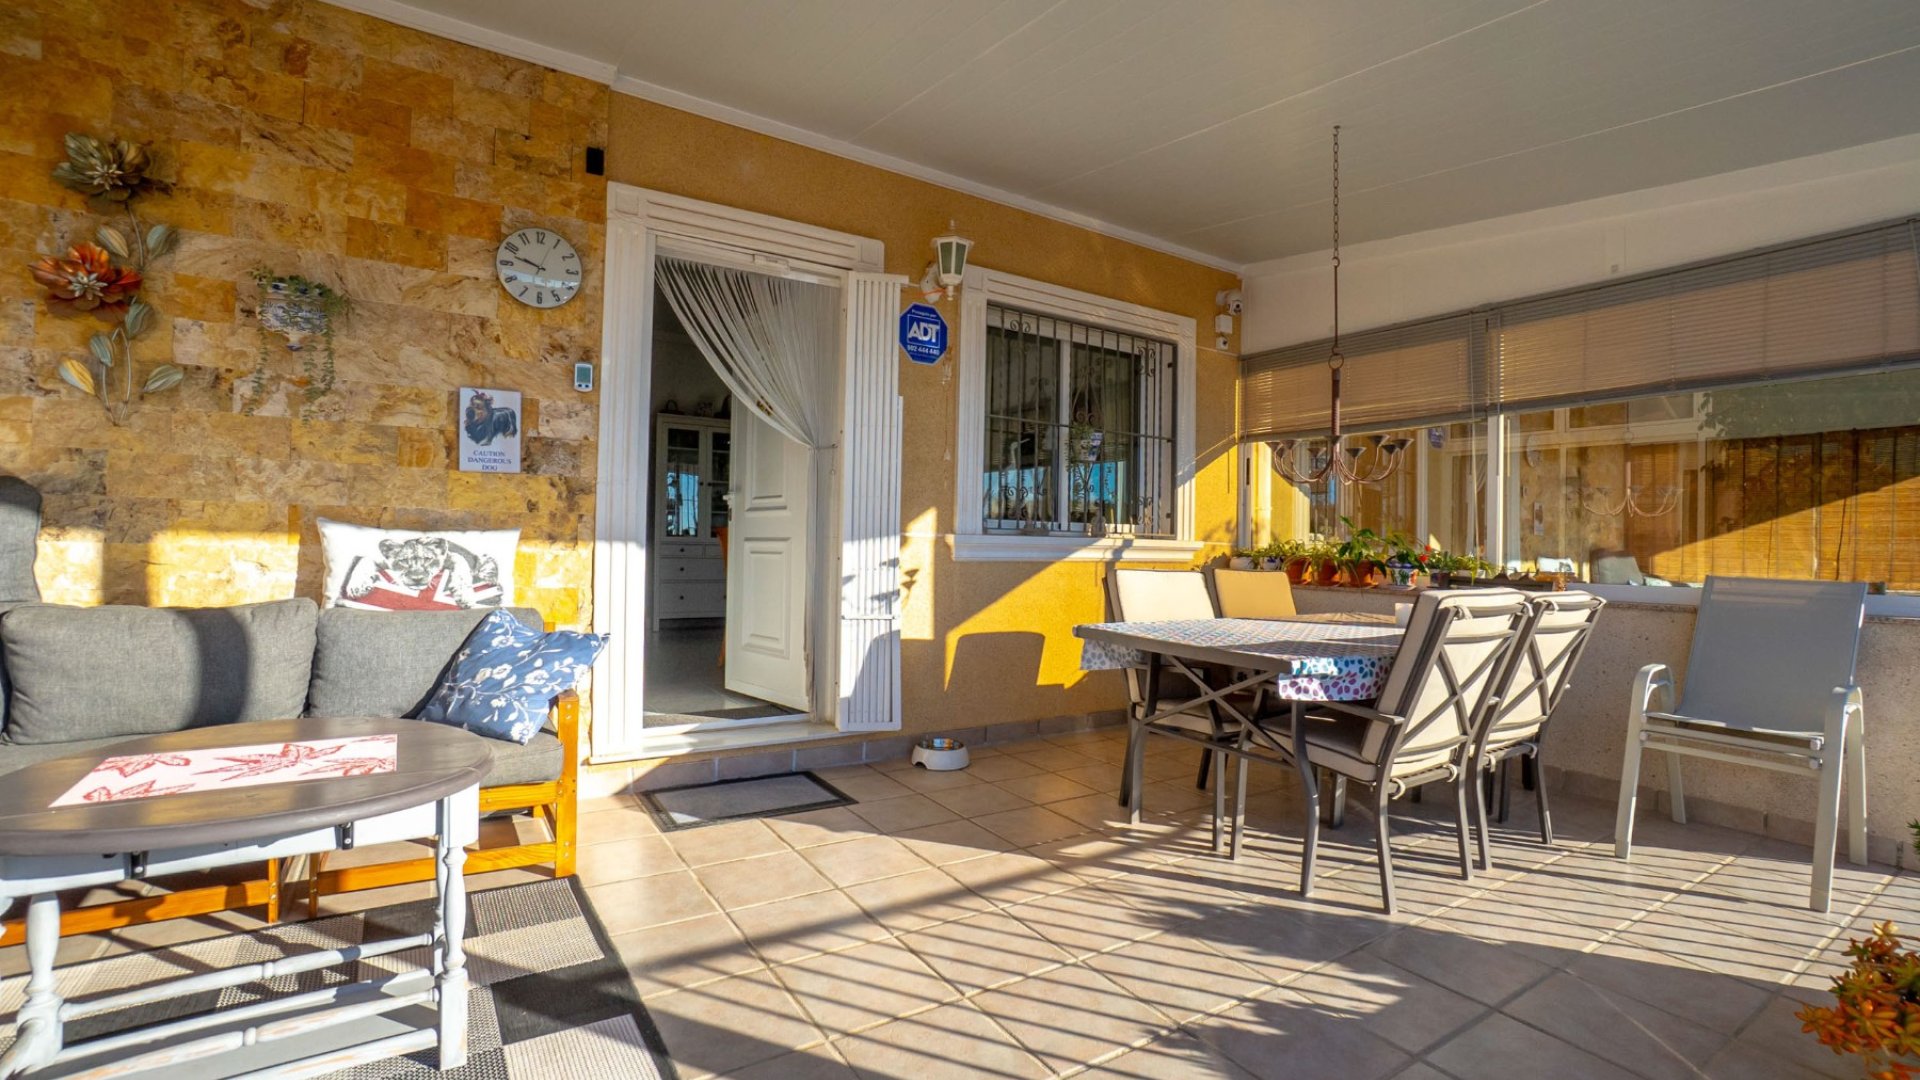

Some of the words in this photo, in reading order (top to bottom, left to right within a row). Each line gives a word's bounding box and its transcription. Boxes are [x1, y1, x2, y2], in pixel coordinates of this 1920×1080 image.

[518, 232, 530, 245] 11
[536, 232, 546, 245] 12
[553, 239, 561, 249] 1
[504, 242, 519, 255] 10
[562, 253, 575, 261] 2
[505, 275, 518, 283] 8
[519, 285, 529, 297] 7
[551, 290, 561, 302] 5
[536, 291, 543, 304] 6
[907, 321, 940, 342] ADT
